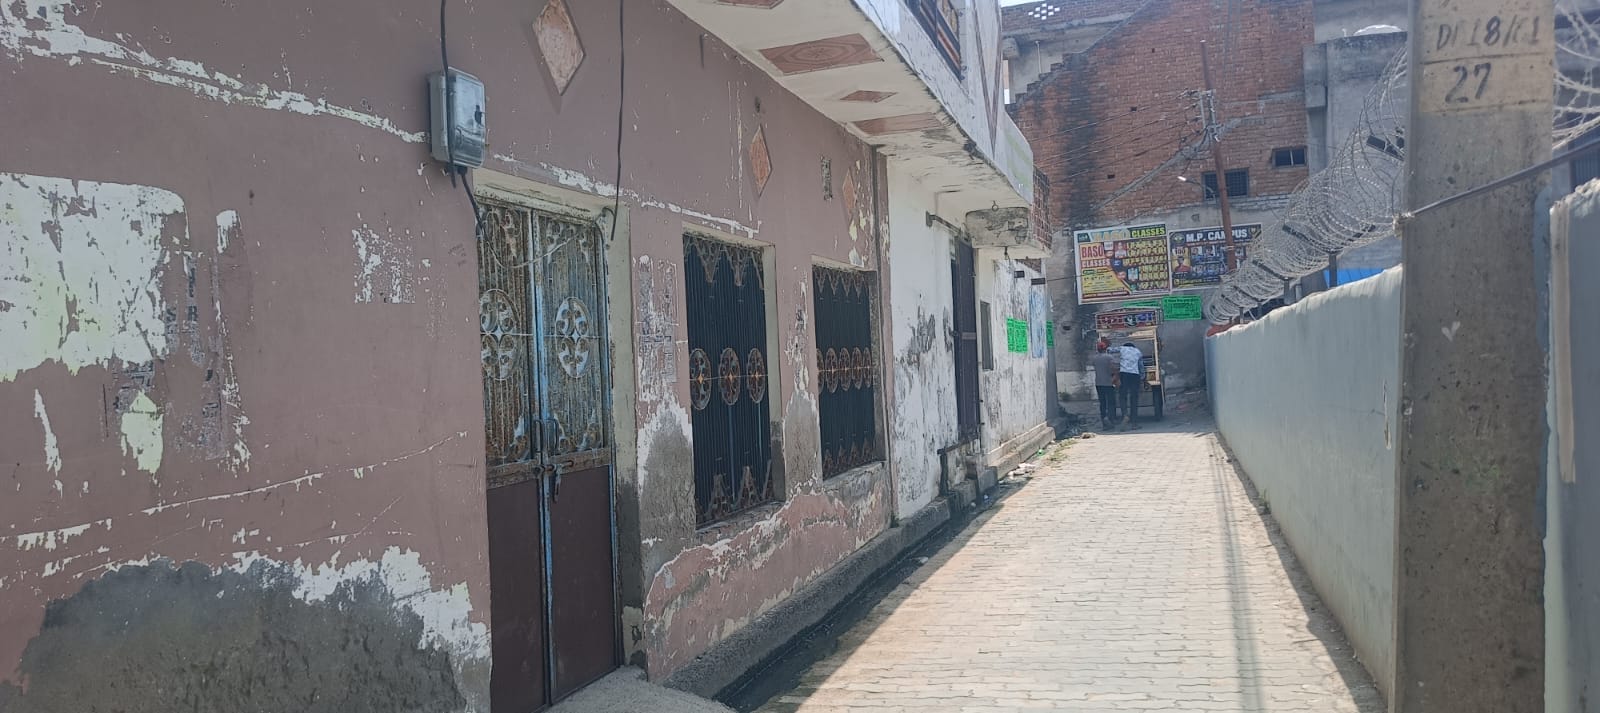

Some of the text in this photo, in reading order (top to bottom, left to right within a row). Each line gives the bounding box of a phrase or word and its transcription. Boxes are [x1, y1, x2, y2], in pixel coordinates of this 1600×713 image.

[1445, 62, 1491, 104] 27
[1131, 227, 1165, 238] CLASSES
[1186, 233, 1206, 243] M.P.
[1081, 245, 1104, 258] BASO
[1081, 258, 1111, 268] CLASSES
